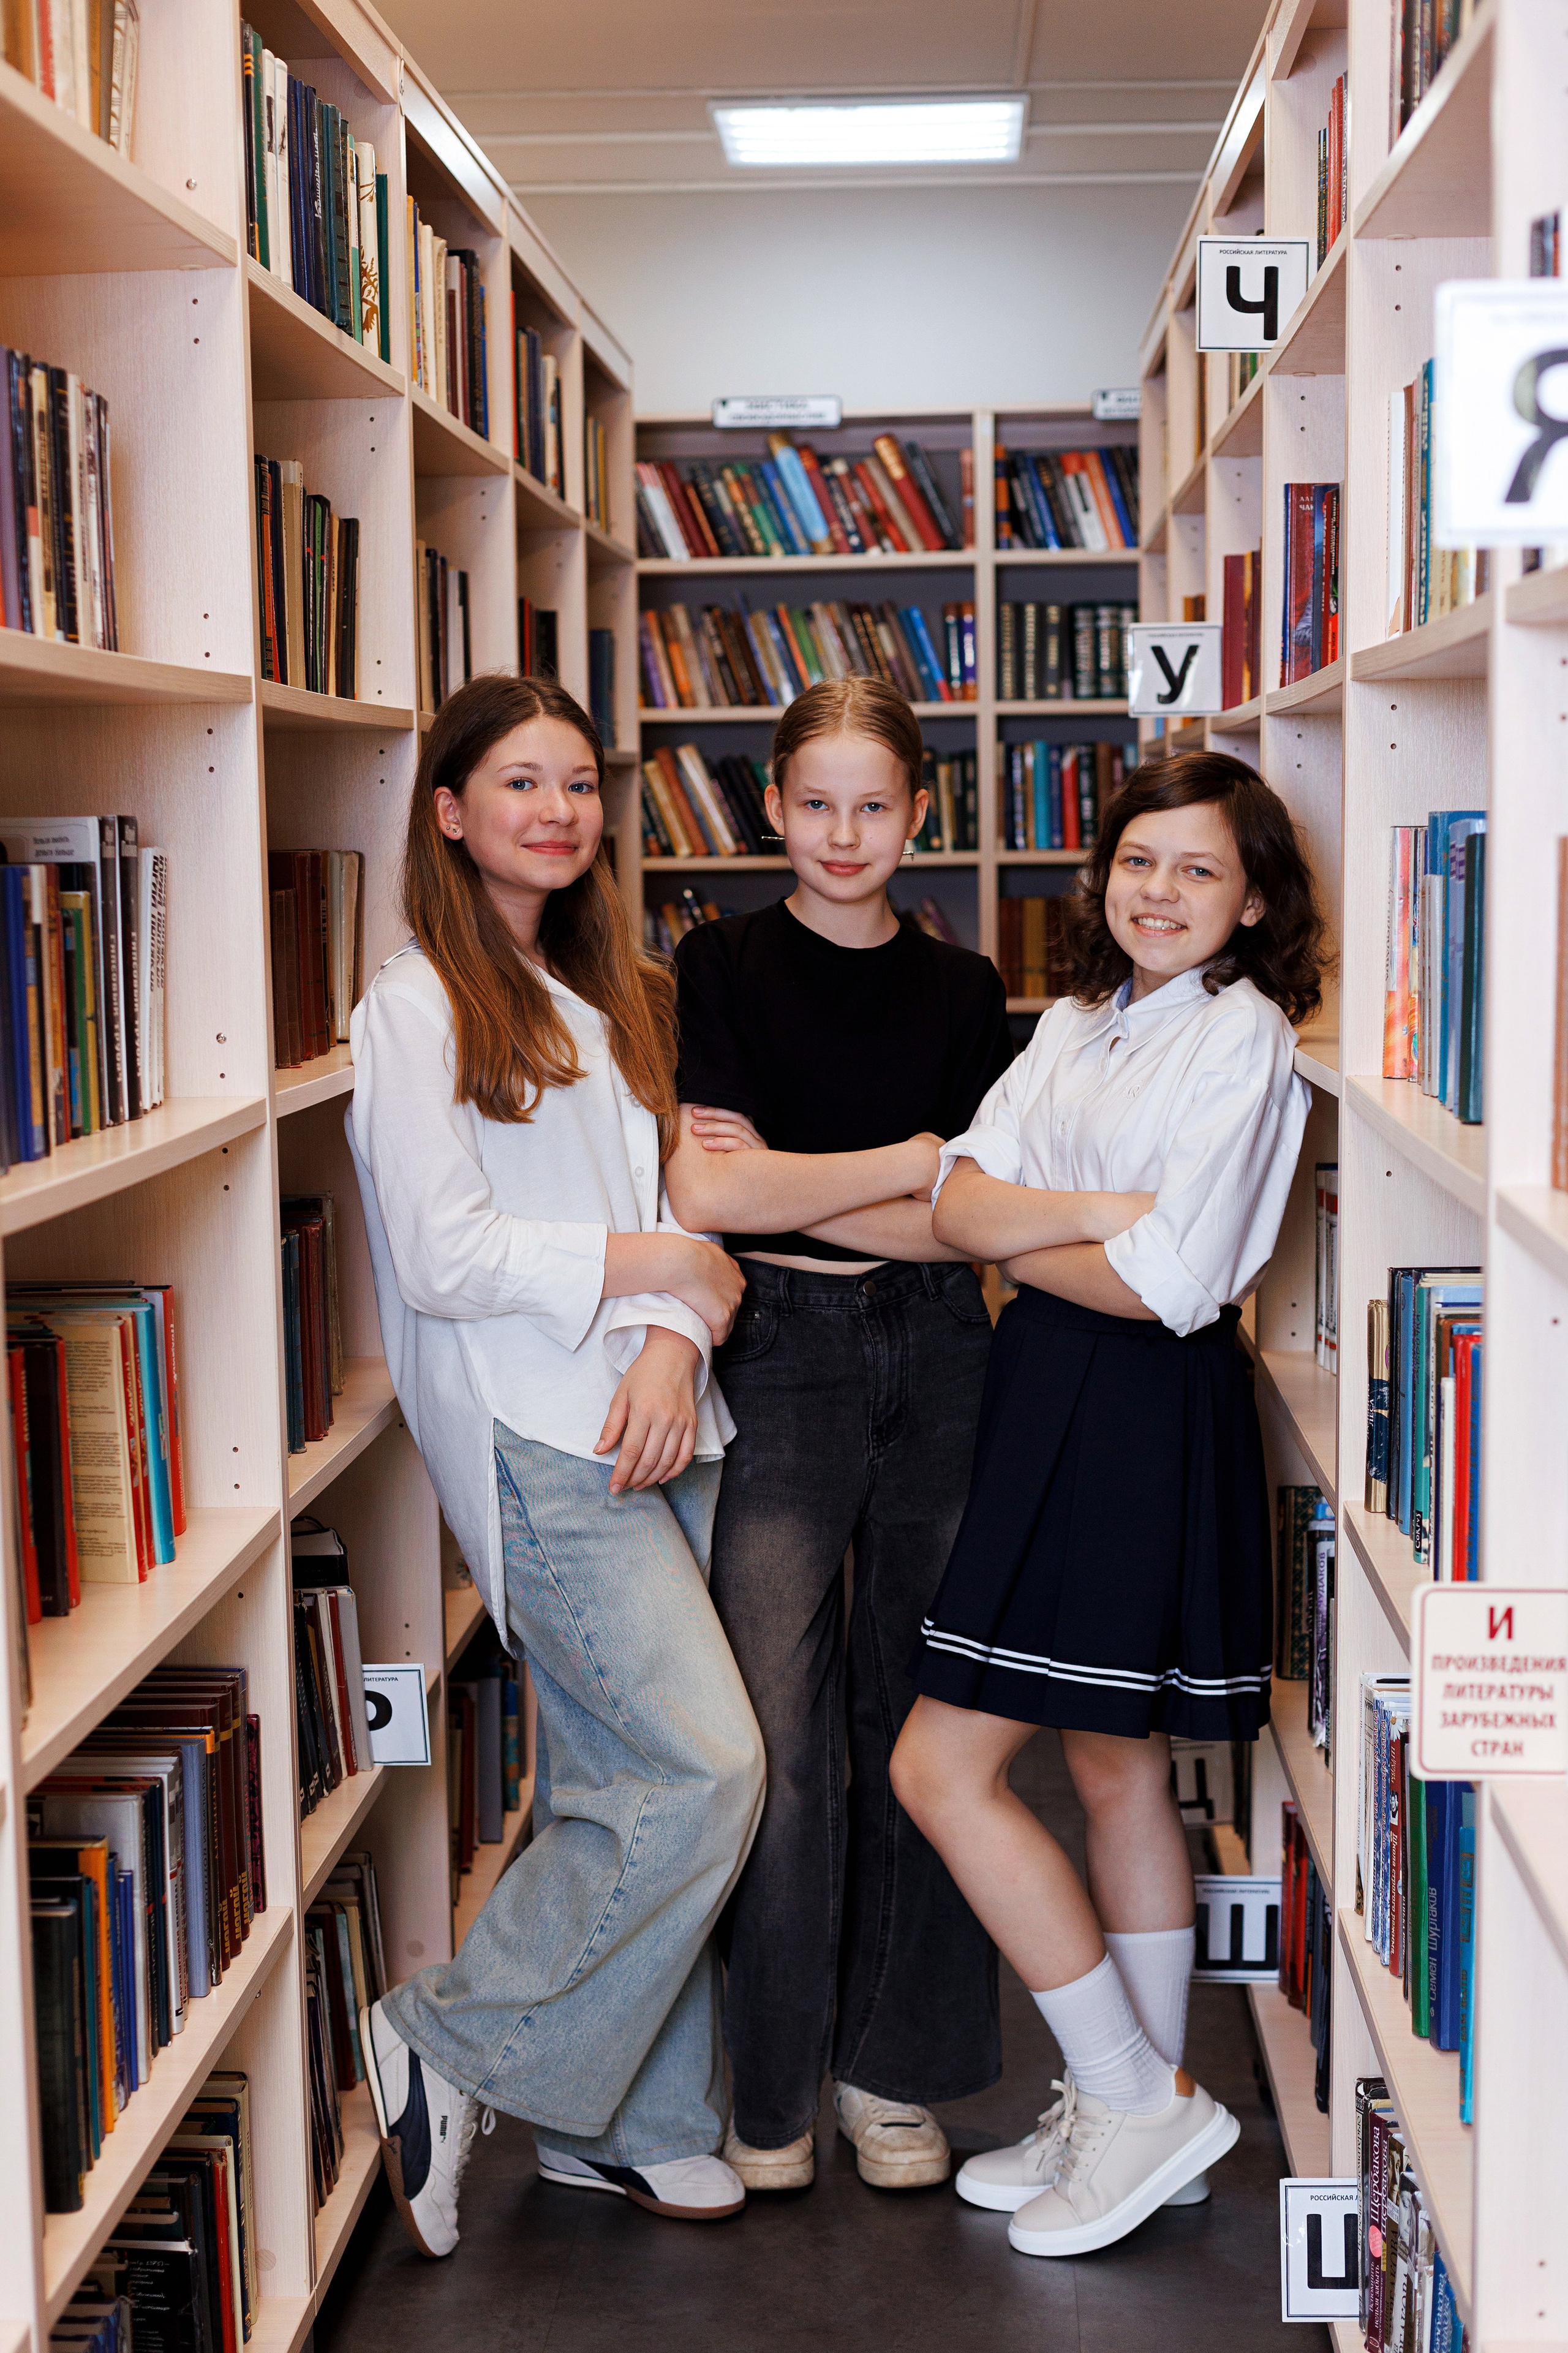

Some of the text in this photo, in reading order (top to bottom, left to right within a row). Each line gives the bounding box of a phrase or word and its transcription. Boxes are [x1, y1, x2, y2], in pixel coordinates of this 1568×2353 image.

[1226, 265, 1279, 341] Ч
[1151, 645, 1199, 704] У
[1488, 1606, 1513, 1640] И
[1431, 1656, 1566, 1673] ПРОИЗВЕДЕНИЯ
[1442, 1683, 1554, 1700] ЛИТЕРАТУРЫ
[1441, 1712, 1556, 1728] ЗАРУБЕЖНЫХ
[1471, 1740, 1523, 1756] СТРАН
[1370, 2126, 1382, 2224] Щербакова
